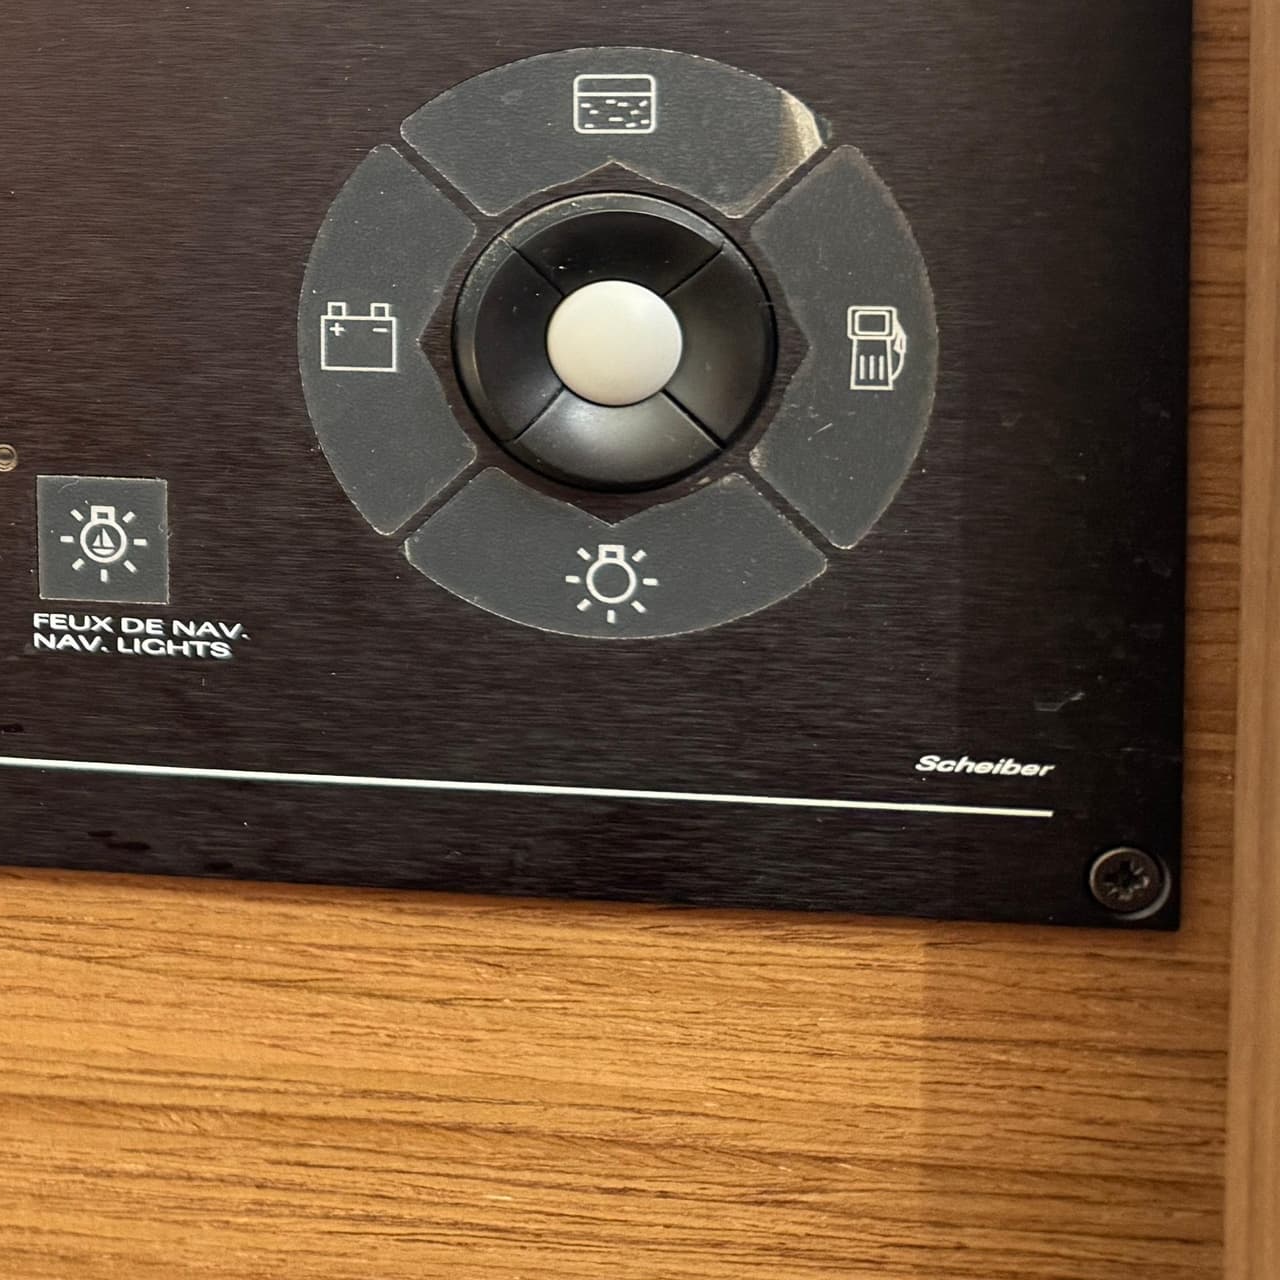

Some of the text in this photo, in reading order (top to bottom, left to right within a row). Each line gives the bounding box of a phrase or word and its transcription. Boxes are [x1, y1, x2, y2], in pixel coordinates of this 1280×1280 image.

[33, 612, 251, 641] FEUX DE NAV.
[33, 632, 233, 658] NAV. LIGHTS
[915, 754, 1056, 777] Scheiber
